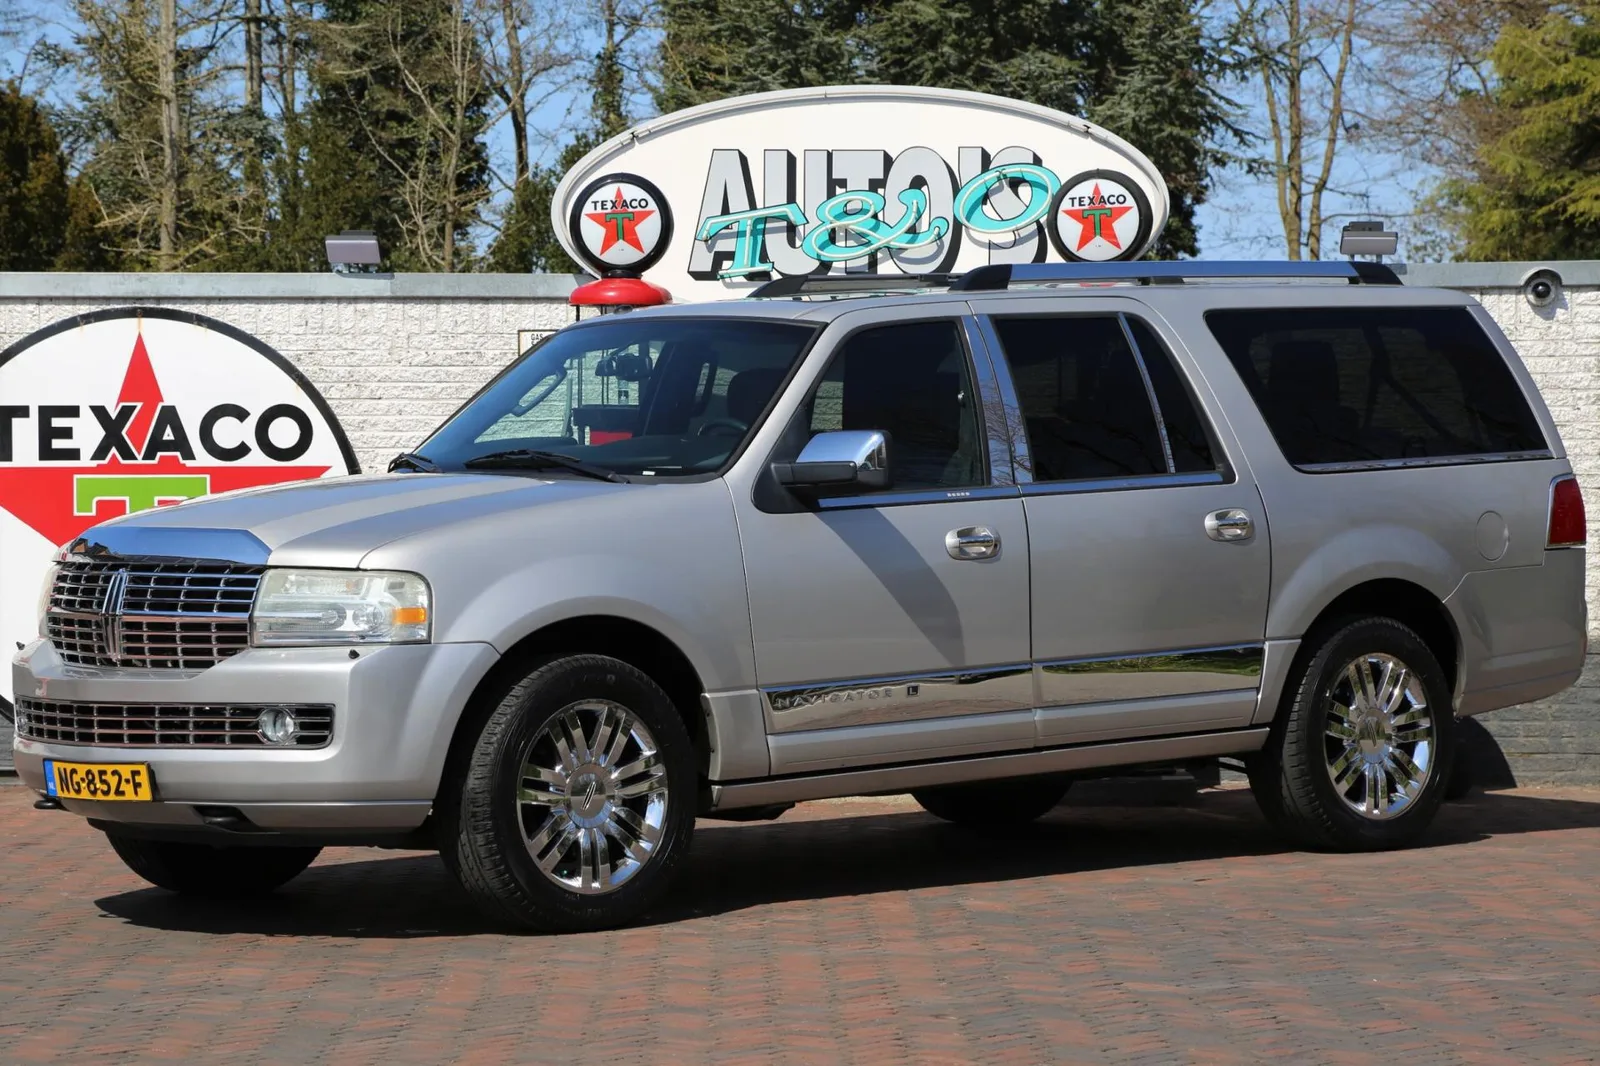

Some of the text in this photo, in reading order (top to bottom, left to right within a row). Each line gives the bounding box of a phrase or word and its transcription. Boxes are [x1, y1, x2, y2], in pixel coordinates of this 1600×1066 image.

[591, 198, 649, 211] TEXACO
[1068, 194, 1127, 207] TEXACO
[605, 211, 634, 241] T
[696, 163, 1062, 280] T&O
[1082, 207, 1113, 238] T
[0, 403, 313, 462] TEXACO
[57, 767, 142, 796] NG-852-F
